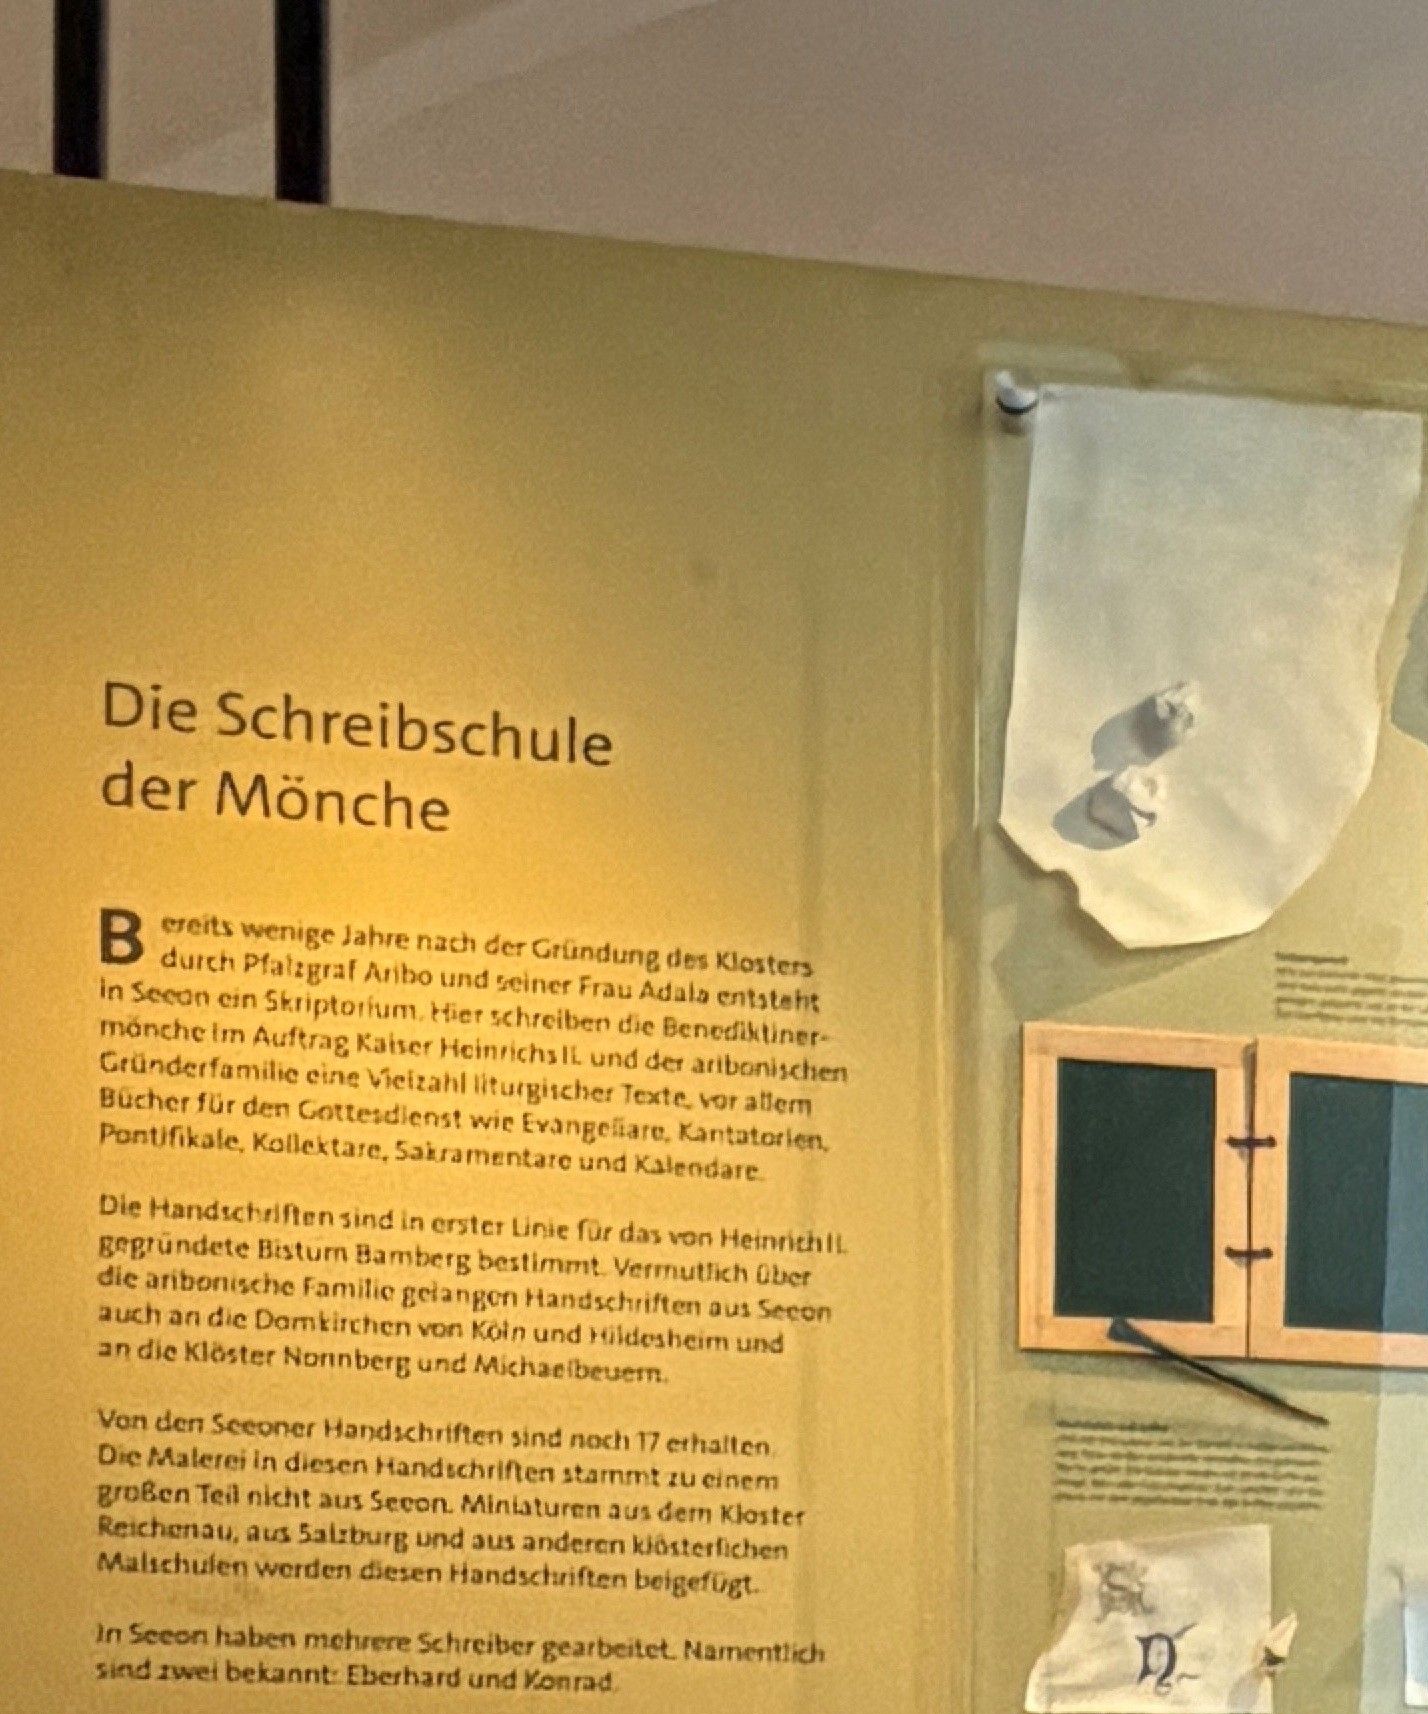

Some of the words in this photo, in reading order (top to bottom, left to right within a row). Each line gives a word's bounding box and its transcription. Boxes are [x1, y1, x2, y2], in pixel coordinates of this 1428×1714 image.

[103, 681, 198, 732] Die
[217, 692, 614, 767] Schreibschule
[102, 760, 197, 813] der
[216, 771, 452, 834] Mönche
[240, 921, 335, 948] wenige
[341, 923, 409, 949] Jahre
[416, 931, 476, 953] nach
[484, 933, 526, 956] der
[531, 937, 659, 970] Gründung
[666, 947, 708, 969] des
[715, 949, 814, 976] Klosters
[159, 946, 234, 972] durch
[363, 960, 433, 986] Aribo
[440, 968, 489, 989] und
[495, 971, 572, 995] seiner
[578, 974, 632, 999] Frau
[716, 986, 819, 1011] entsteht
[100, 976, 123, 1001] in
[130, 980, 210, 1007] Seeon
[217, 991, 257, 1009] ein
[430, 1000, 483, 1024] Hier
[490, 1005, 610, 1032] schreiben
[617, 1013, 654, 1035] die
[100, 1014, 205, 1042] mönche
[211, 1021, 245, 1044] im
[252, 1023, 349, 1056] Auftrag
[356, 1031, 432, 1056] Kaiser
[440, 1036, 557, 1064] Heinrichs
[590, 1047, 638, 1069] und
[644, 1049, 683, 1071] der
[690, 1053, 848, 1081] aribonischen
[99, 1049, 299, 1084] Gründerfamilie
[305, 1062, 359, 1087] eine
[366, 1066, 466, 1093] Vielzahl
[474, 1072, 613, 1103] liturgischer
[698, 1092, 737, 1109] vor
[744, 1089, 812, 1114] allem
[99, 1085, 190, 1113] Bücher
[196, 1091, 235, 1115] für
[242, 1094, 289, 1118] den
[297, 1098, 461, 1128] Gottesdienst
[469, 1110, 514, 1131] wie
[99, 1120, 244, 1153] Pontifikale,
[252, 1131, 388, 1162] Kollektare,
[395, 1139, 572, 1169] Sakramentare
[578, 1151, 626, 1172] und
[98, 1192, 141, 1218] Die
[149, 1195, 333, 1227] Handschriften
[339, 1207, 393, 1230] sind
[401, 1210, 424, 1231] in
[430, 1214, 504, 1236] erster
[512, 1216, 569, 1239] Linie
[576, 1217, 612, 1241] für
[618, 1220, 661, 1244] das
[668, 1230, 713, 1246] von
[720, 1226, 822, 1252] Heinrich
[98, 1231, 249, 1259] gegründete
[257, 1238, 348, 1263] Bistum
[355, 1242, 471, 1274] Bamberg
[613, 1256, 748, 1282] Vermutlich
[755, 1263, 811, 1285] über
[96, 1264, 138, 1289] die
[144, 1268, 295, 1296] aribonische
[302, 1275, 395, 1301] Familie
[402, 1280, 517, 1310] gelangen
[525, 1286, 701, 1315] Handschriften
[708, 1300, 751, 1317] aus
[757, 1298, 831, 1321] Seeon
[98, 1301, 161, 1325] auch
[168, 1308, 200, 1327] an
[206, 1305, 247, 1329] die
[254, 1307, 411, 1336] Domkirchen
[417, 1321, 463, 1338] von
[471, 1318, 526, 1341] Köln
[532, 1323, 581, 1344] und
[736, 1331, 784, 1353] und
[97, 1341, 131, 1359] an
[136, 1338, 177, 1362] die
[184, 1339, 275, 1366] Klöster
[283, 1344, 411, 1376] Nonnberg
[417, 1351, 466, 1374] und
[96, 1407, 148, 1432] Von
[154, 1408, 204, 1434] den
[323, 1416, 503, 1445] Handschriften
[510, 1425, 562, 1447] sind
[569, 1429, 629, 1450] noch
[637, 1430, 660, 1451] 17
[97, 1442, 141, 1467] Die
[146, 1444, 246, 1471] Malerei
[252, 1448, 277, 1472] in
[284, 1450, 368, 1474] diesen
[375, 1454, 555, 1482] Handschriften
[562, 1463, 660, 1485] stammt
[668, 1470, 696, 1487] zu
[701, 1470, 778, 1490] einem
[96, 1479, 190, 1507] großen
[194, 1481, 239, 1506] Teil
[246, 1483, 311, 1509] nicht
[318, 1492, 363, 1510] aus
[460, 1492, 600, 1518] Miniaturen
[607, 1502, 651, 1520] aus
[656, 1500, 712, 1522] dem
[720, 1502, 805, 1525] Kloster
[97, 1514, 239, 1544] Reichenau,
[246, 1524, 291, 1543] aus
[297, 1521, 408, 1552] Salzburg
[415, 1526, 464, 1548] und
[471, 1533, 515, 1550] aus
[521, 1530, 625, 1553] anderen
[96, 1550, 248, 1577] Malschulen
[254, 1557, 351, 1580] werden
[358, 1559, 442, 1583] diesen
[449, 1560, 627, 1588] Handschriften
[634, 1567, 759, 1596] beigefügt.
[96, 1622, 122, 1643] In
[128, 1622, 208, 1646] Seeon
[215, 1623, 296, 1649] haben
[304, 1628, 411, 1652] mehrere
[417, 1630, 535, 1655] Schreiber
[683, 1638, 825, 1662] Namentlich
[95, 1657, 151, 1680] sind
[156, 1661, 218, 1682] zwei
[346, 1663, 461, 1687] Eberhard
[467, 1668, 517, 1688] und
